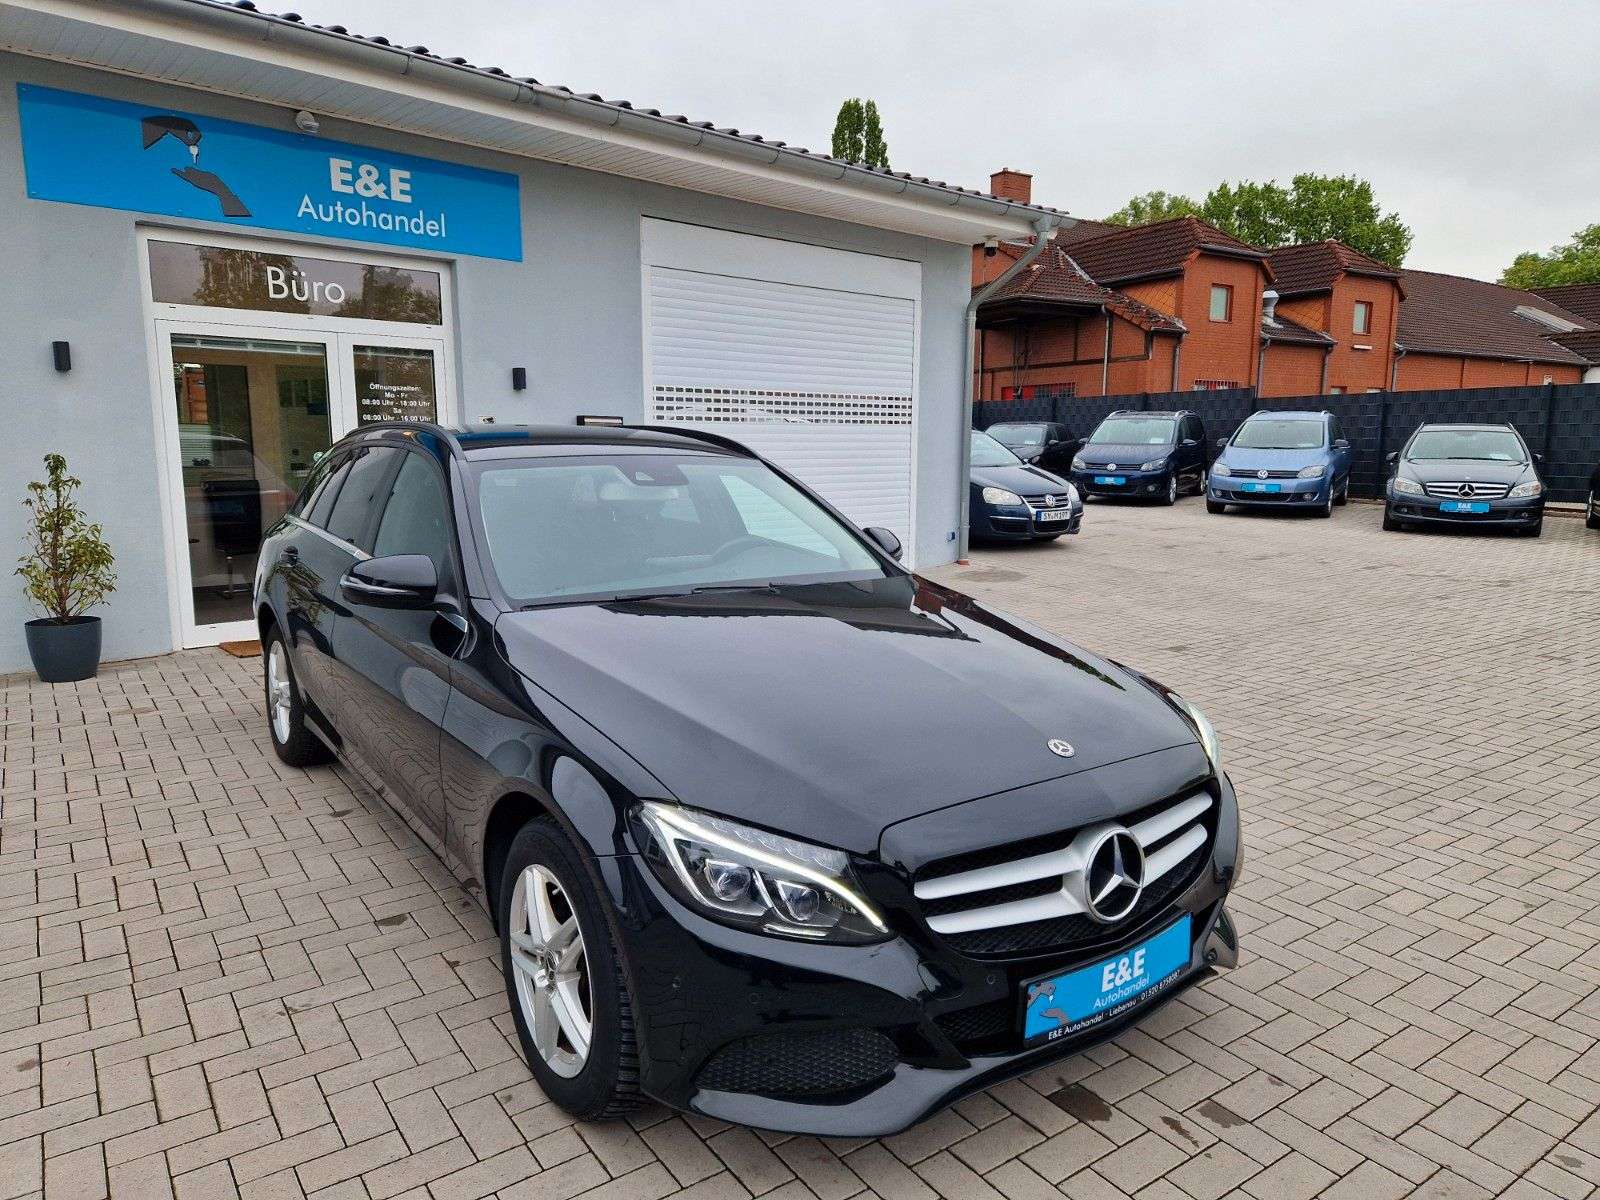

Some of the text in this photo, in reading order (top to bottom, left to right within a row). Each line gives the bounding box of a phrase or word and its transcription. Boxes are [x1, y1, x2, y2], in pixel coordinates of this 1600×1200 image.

[329, 157, 412, 204] E&E
[297, 193, 447, 238] Autohandel
[266, 265, 346, 304] Büro
[1093, 971, 1150, 1010] Autohandel
[1101, 947, 1147, 993] E&E
[1048, 1028, 1063, 1041] E&E
[1064, 1012, 1104, 1035] Autohandel
